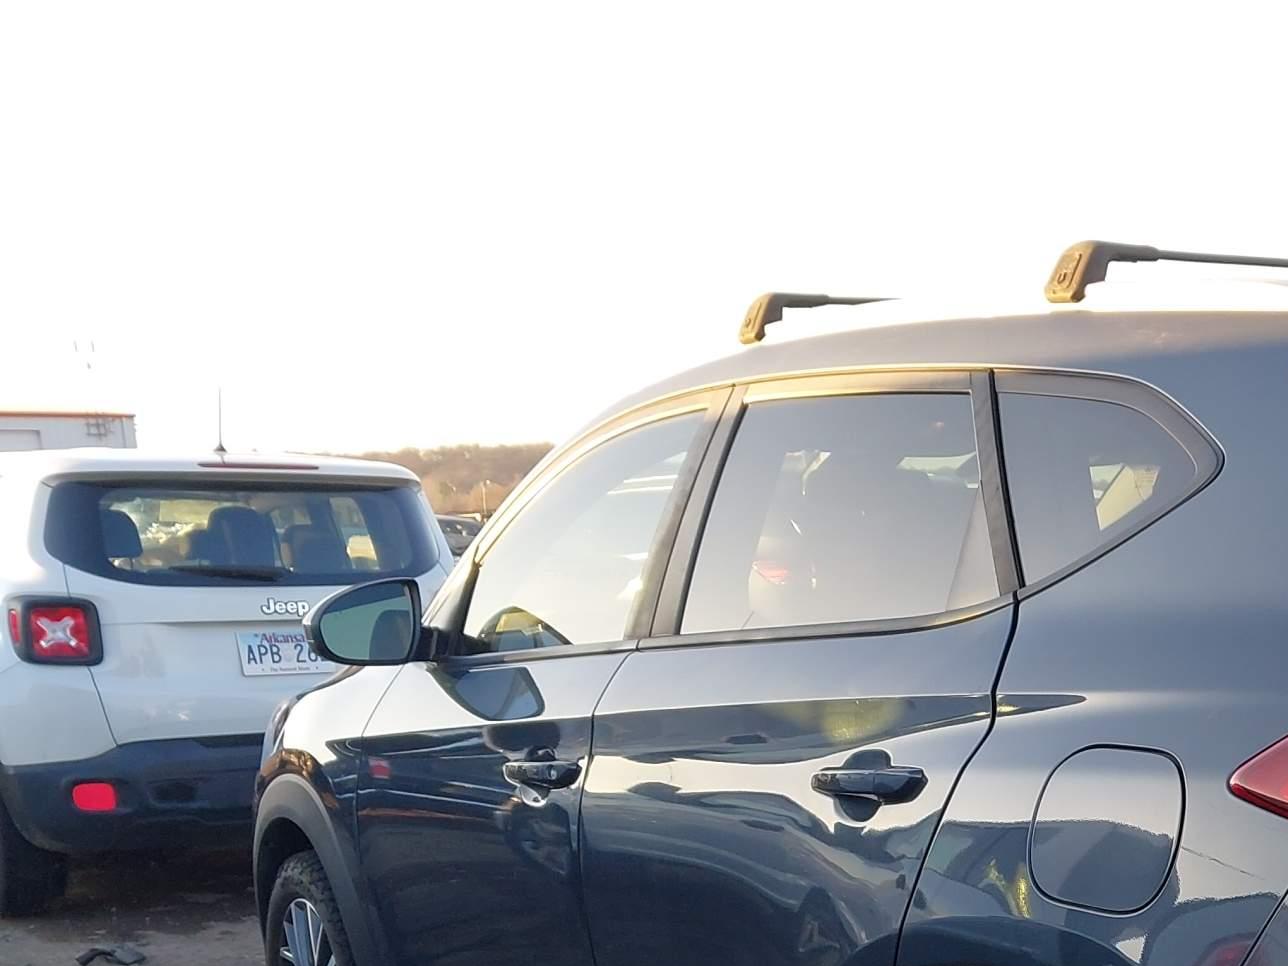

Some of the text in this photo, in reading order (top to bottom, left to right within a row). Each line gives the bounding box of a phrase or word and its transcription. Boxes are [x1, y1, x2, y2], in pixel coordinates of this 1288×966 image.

[261, 597, 310, 617] Jeep
[247, 643, 328, 665] APB 26
